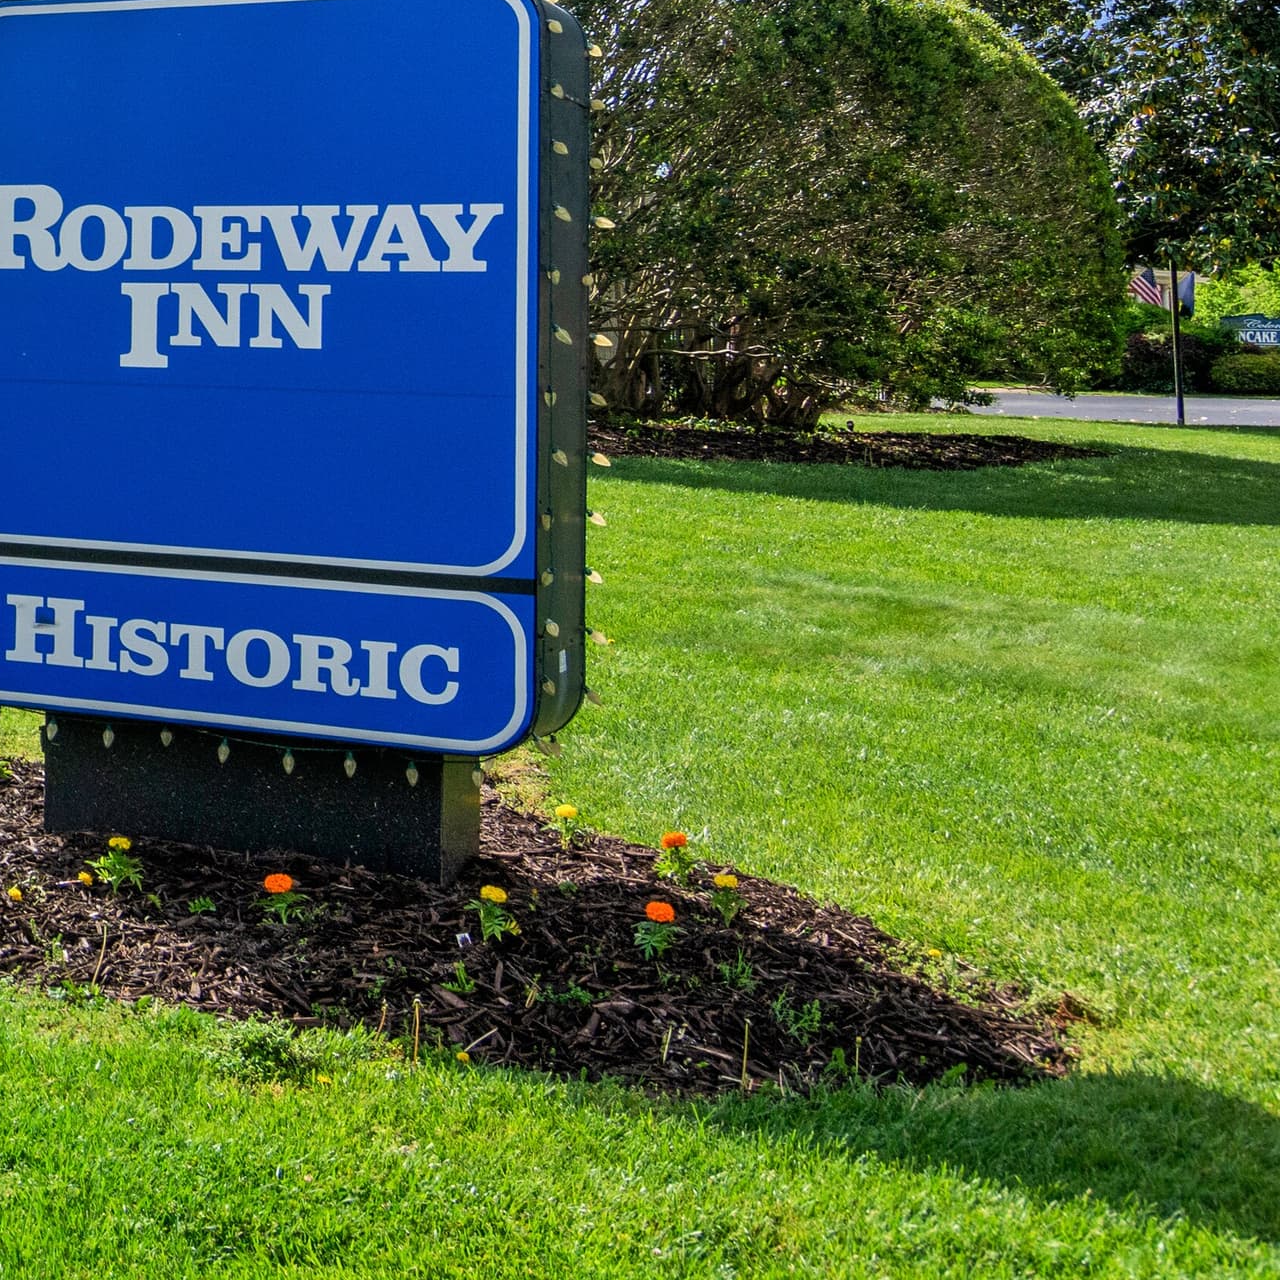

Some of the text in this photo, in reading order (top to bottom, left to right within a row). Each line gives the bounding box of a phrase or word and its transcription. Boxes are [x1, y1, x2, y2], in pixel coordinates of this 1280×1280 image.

[119, 282, 332, 369] INN
[1235, 331, 1278, 343] NCAKE
[5, 594, 460, 705] HISTORIC
